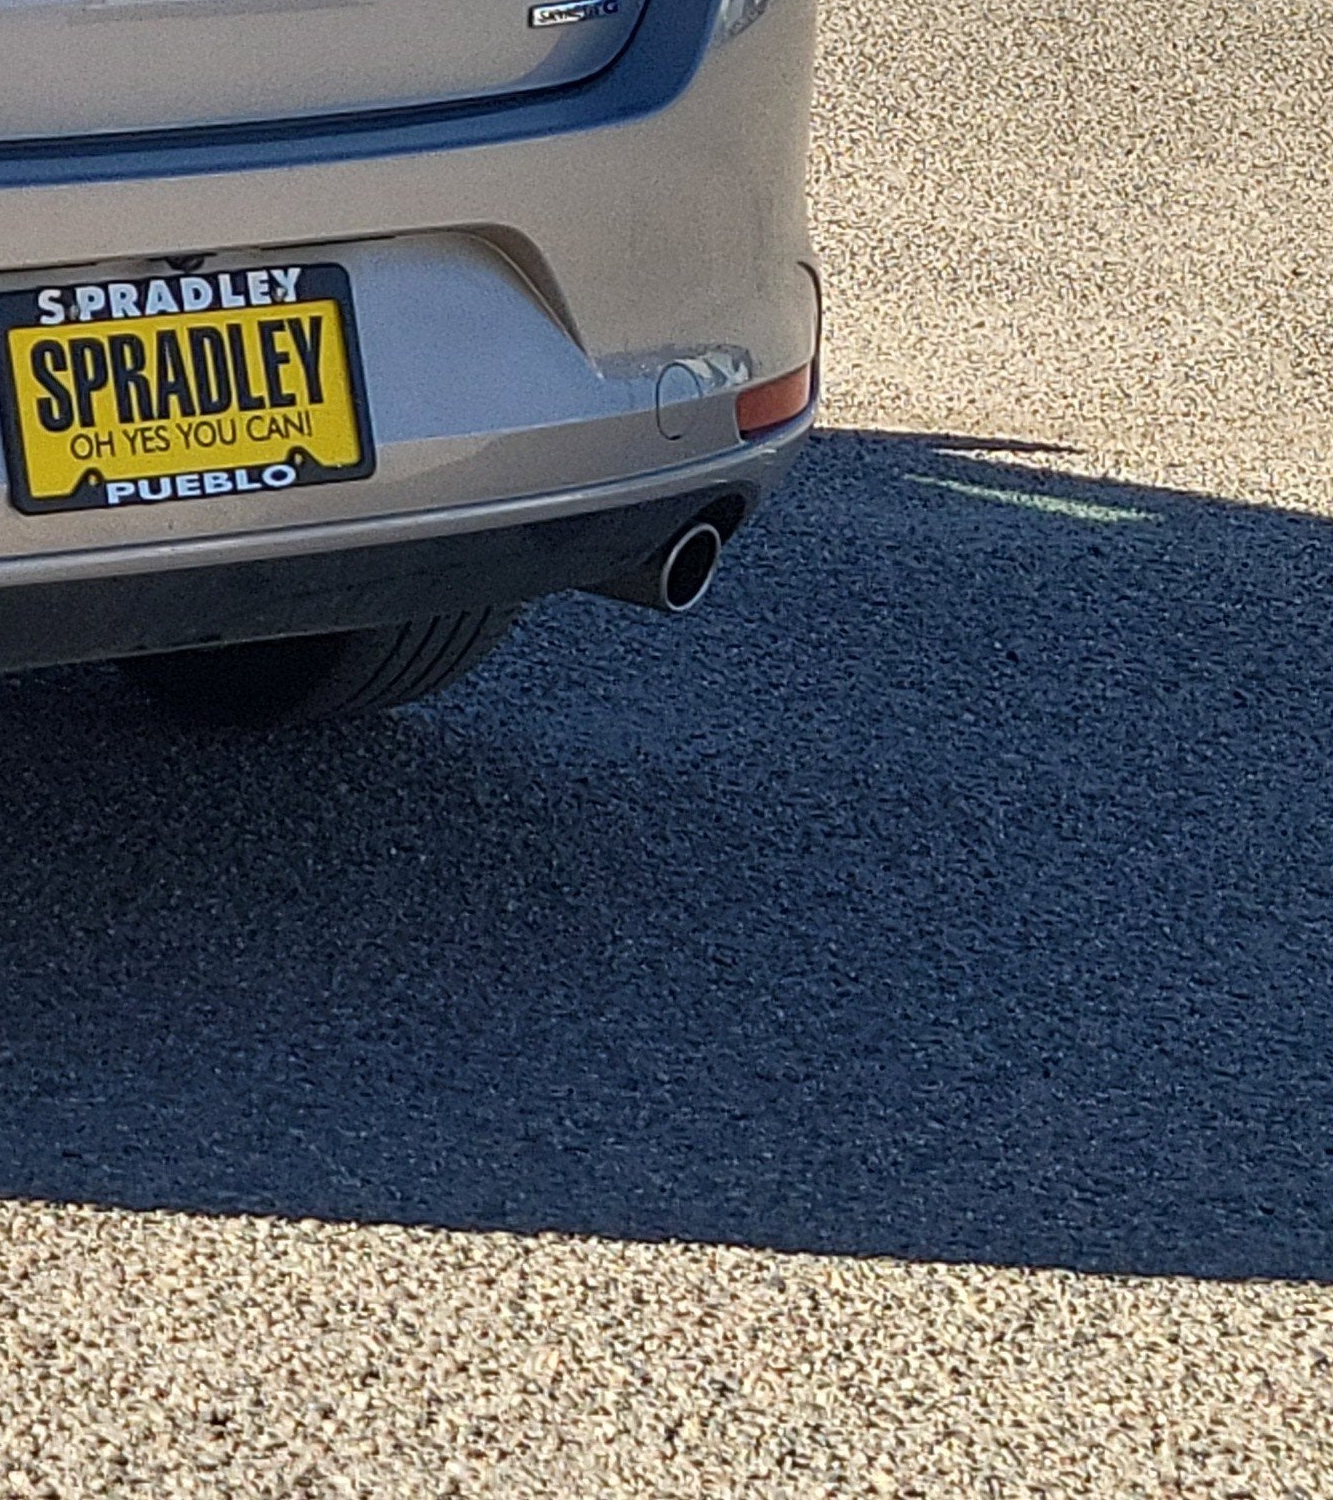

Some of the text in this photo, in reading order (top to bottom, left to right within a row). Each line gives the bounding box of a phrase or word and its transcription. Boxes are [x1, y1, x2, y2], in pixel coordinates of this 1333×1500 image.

[37, 267, 303, 325] SPRADLEY
[30, 315, 325, 433] SPRADLEY
[70, 410, 312, 460] OH YES YOU CAN!
[106, 465, 297, 504] PUEBLO
